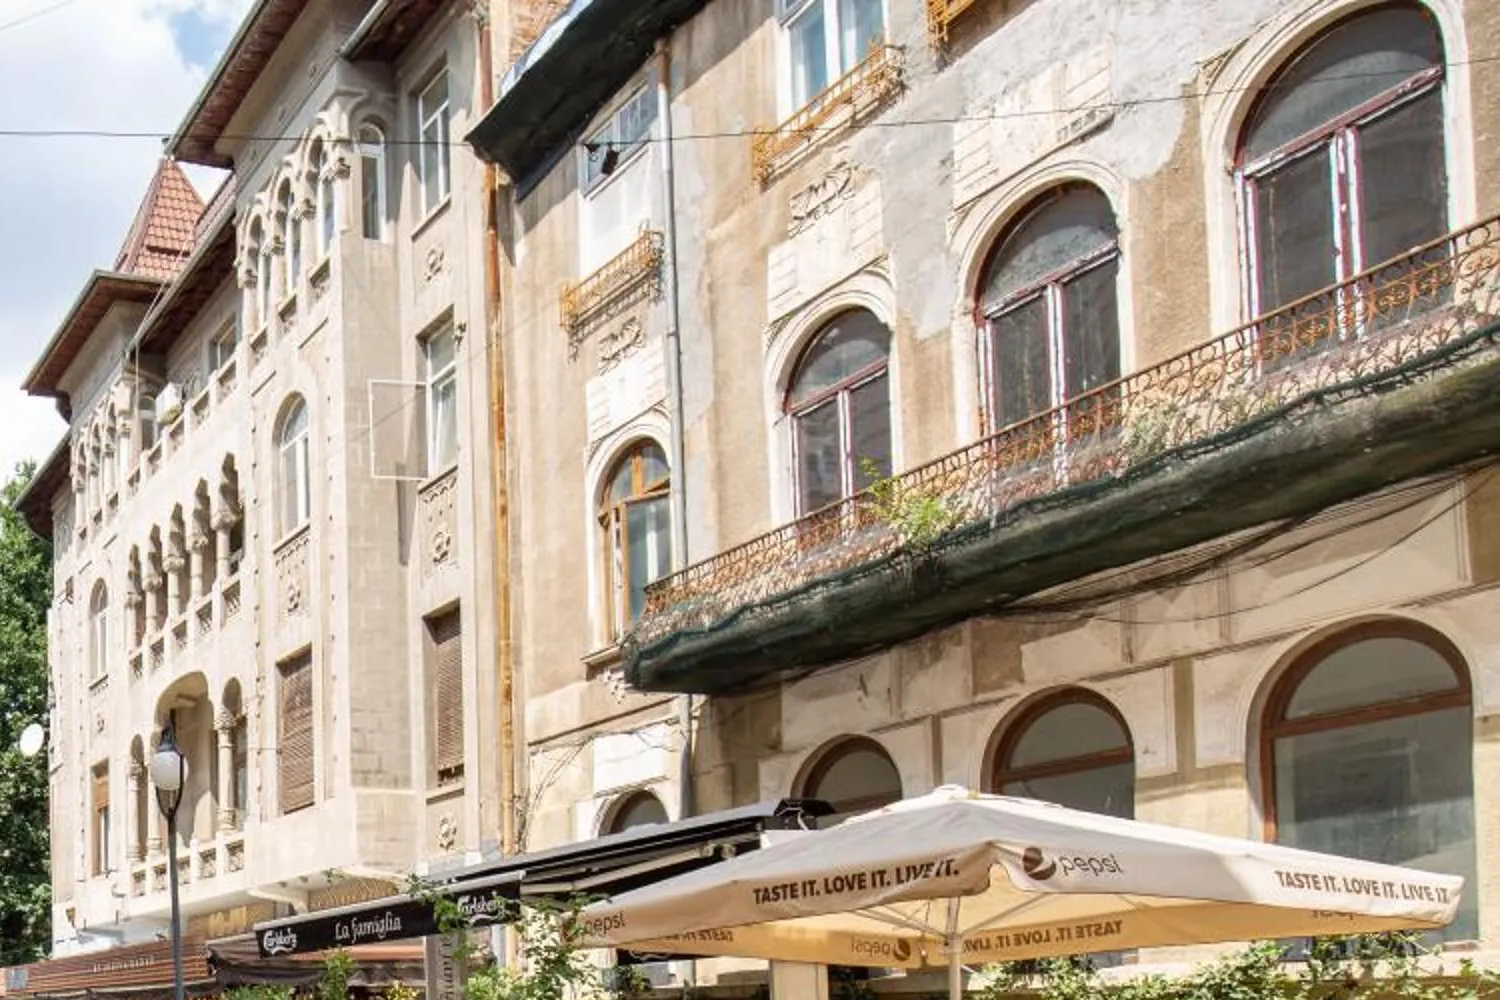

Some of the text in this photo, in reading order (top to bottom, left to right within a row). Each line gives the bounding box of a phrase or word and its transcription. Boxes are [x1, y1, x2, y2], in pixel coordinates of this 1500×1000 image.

[1059, 852, 1124, 877] pepsi
[753, 883, 799, 904] TASTE
[802, 879, 820, 898] IT.
[823, 871, 867, 895] LOVE
[871, 869, 891, 888] IT.
[895, 861, 934, 885] LIVE
[1274, 870, 1322, 891] TASTE
[1323, 875, 1341, 893] IT.
[1343, 876, 1381, 896] LOVE
[1382, 881, 1399, 899] IT.
[1401, 883, 1435, 902] LIVE
[263, 928, 298, 949] Carlsberg
[335, 911, 401, 944] La famiglia
